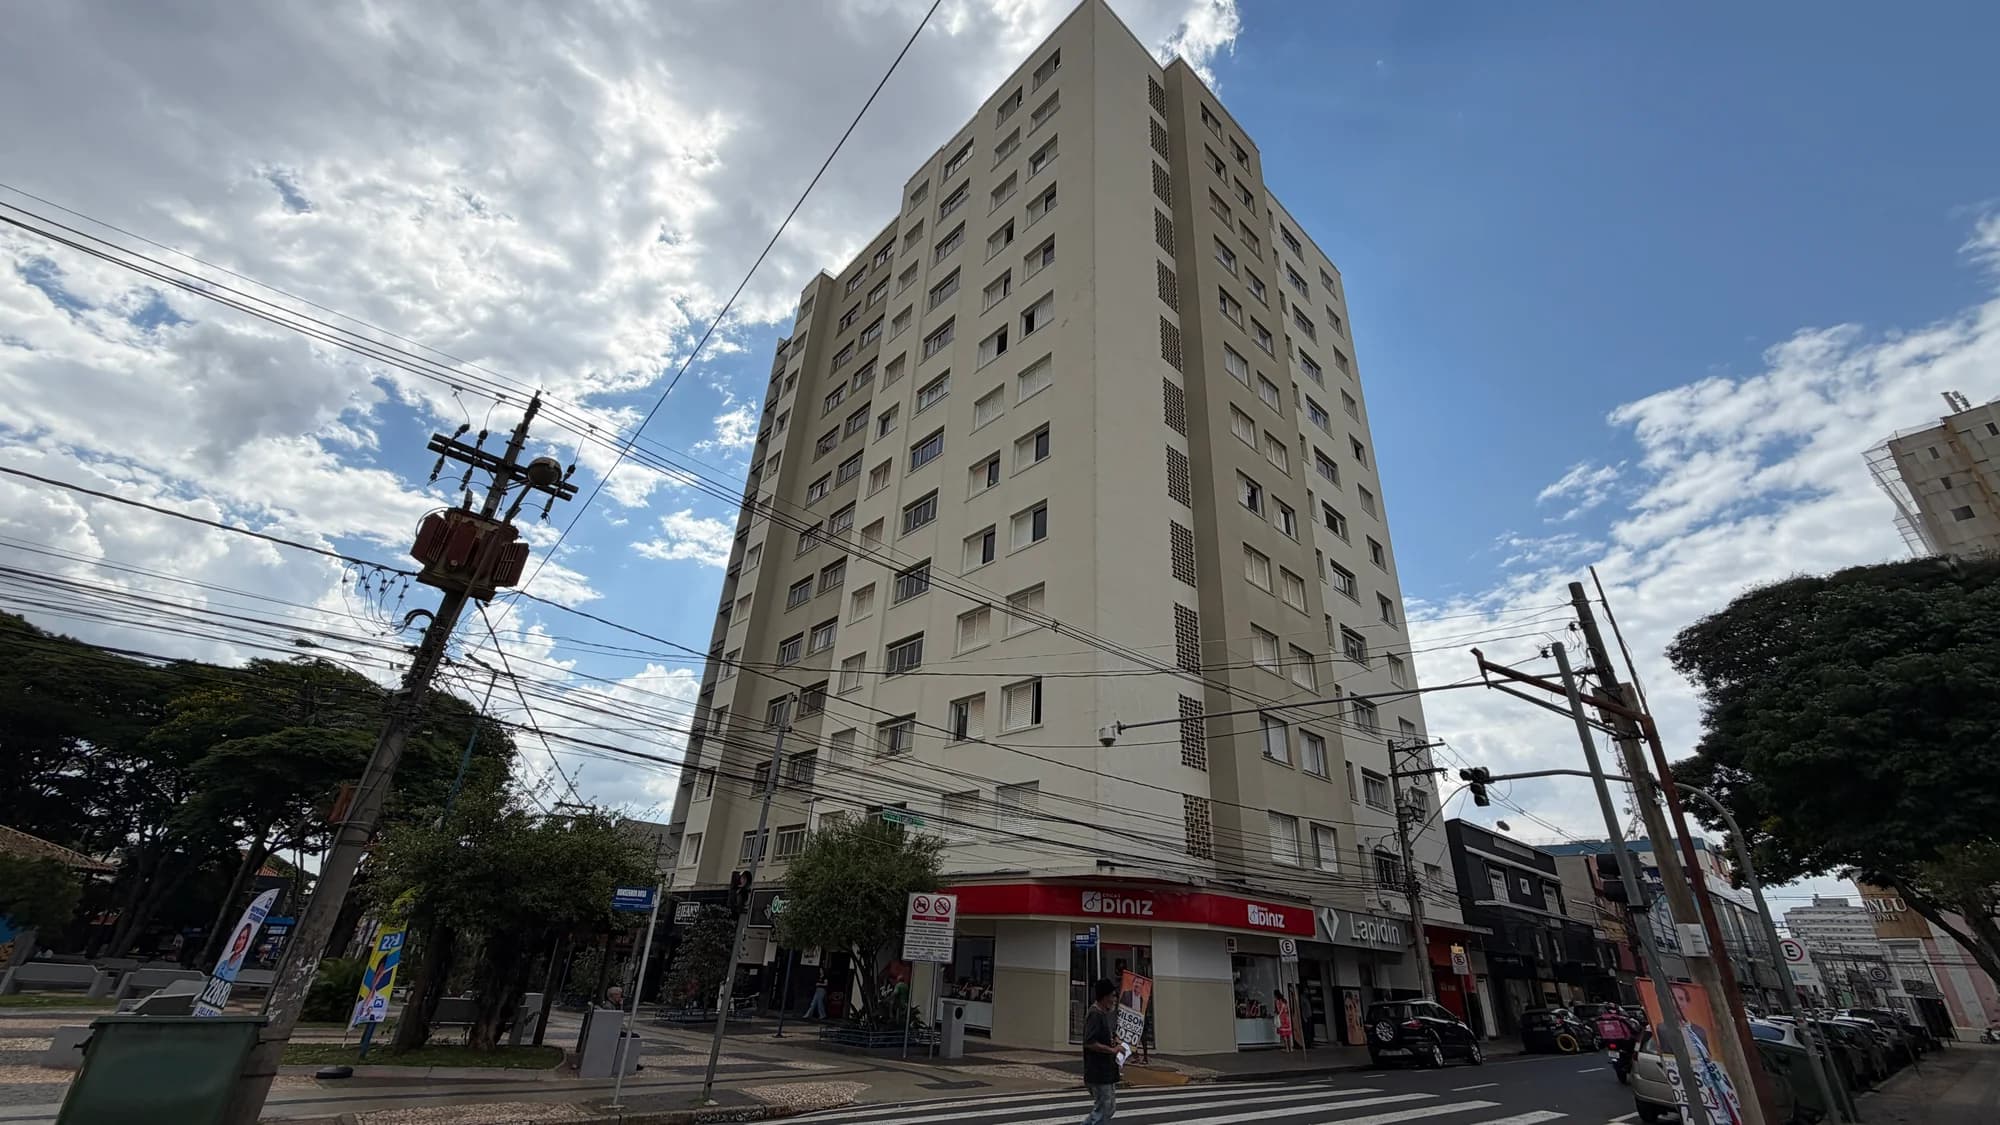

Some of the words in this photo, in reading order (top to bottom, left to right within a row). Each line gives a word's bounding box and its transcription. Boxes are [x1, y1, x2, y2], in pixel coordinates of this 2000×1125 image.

[1102, 898, 1154, 916] DINIZ
[1259, 912, 1286, 929] DINIZ
[1349, 913, 1401, 947] Lapidin
[1285, 942, 1291, 952] E
[1784, 944, 1797, 957] E
[1874, 970, 1883, 981] E
[1117, 1009, 1144, 1028] GILSON
